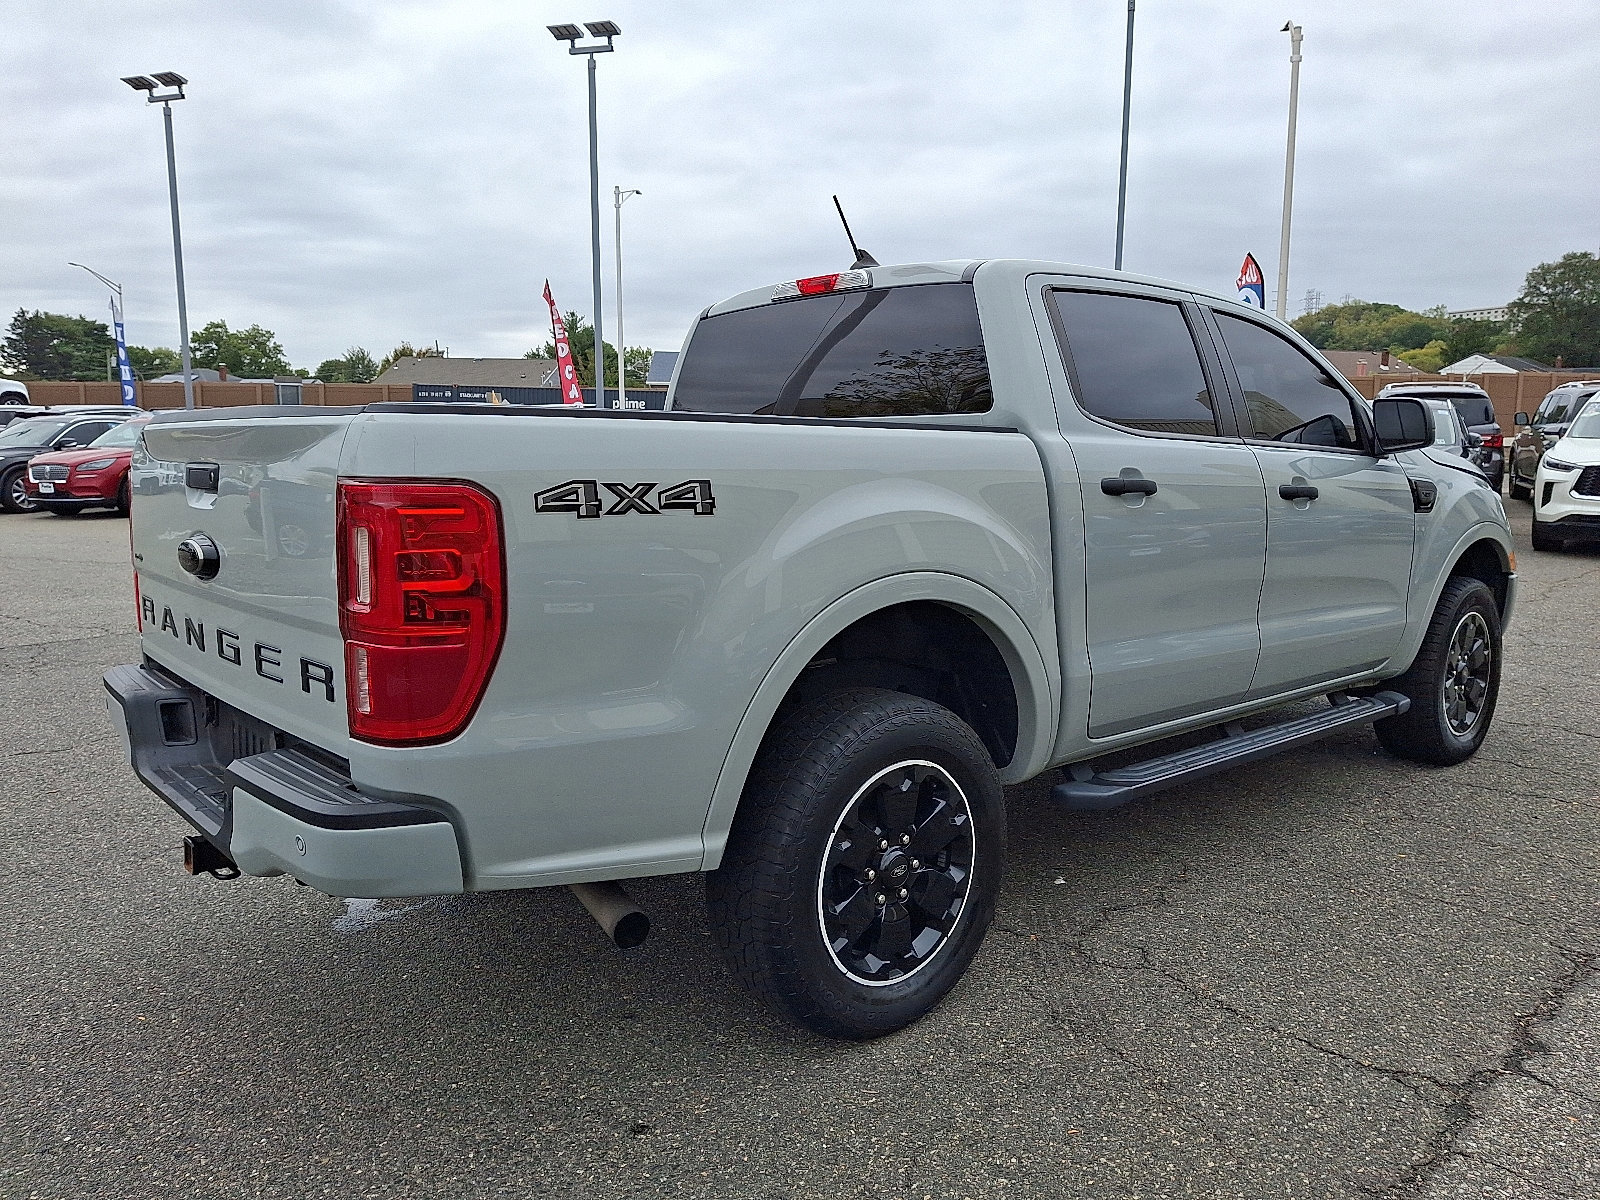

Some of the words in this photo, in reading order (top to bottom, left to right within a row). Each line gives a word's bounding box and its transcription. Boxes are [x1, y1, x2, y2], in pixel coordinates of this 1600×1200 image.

[612, 397, 646, 409] pime
[534, 479, 716, 519] 4X4
[141, 595, 336, 702] RANGER
